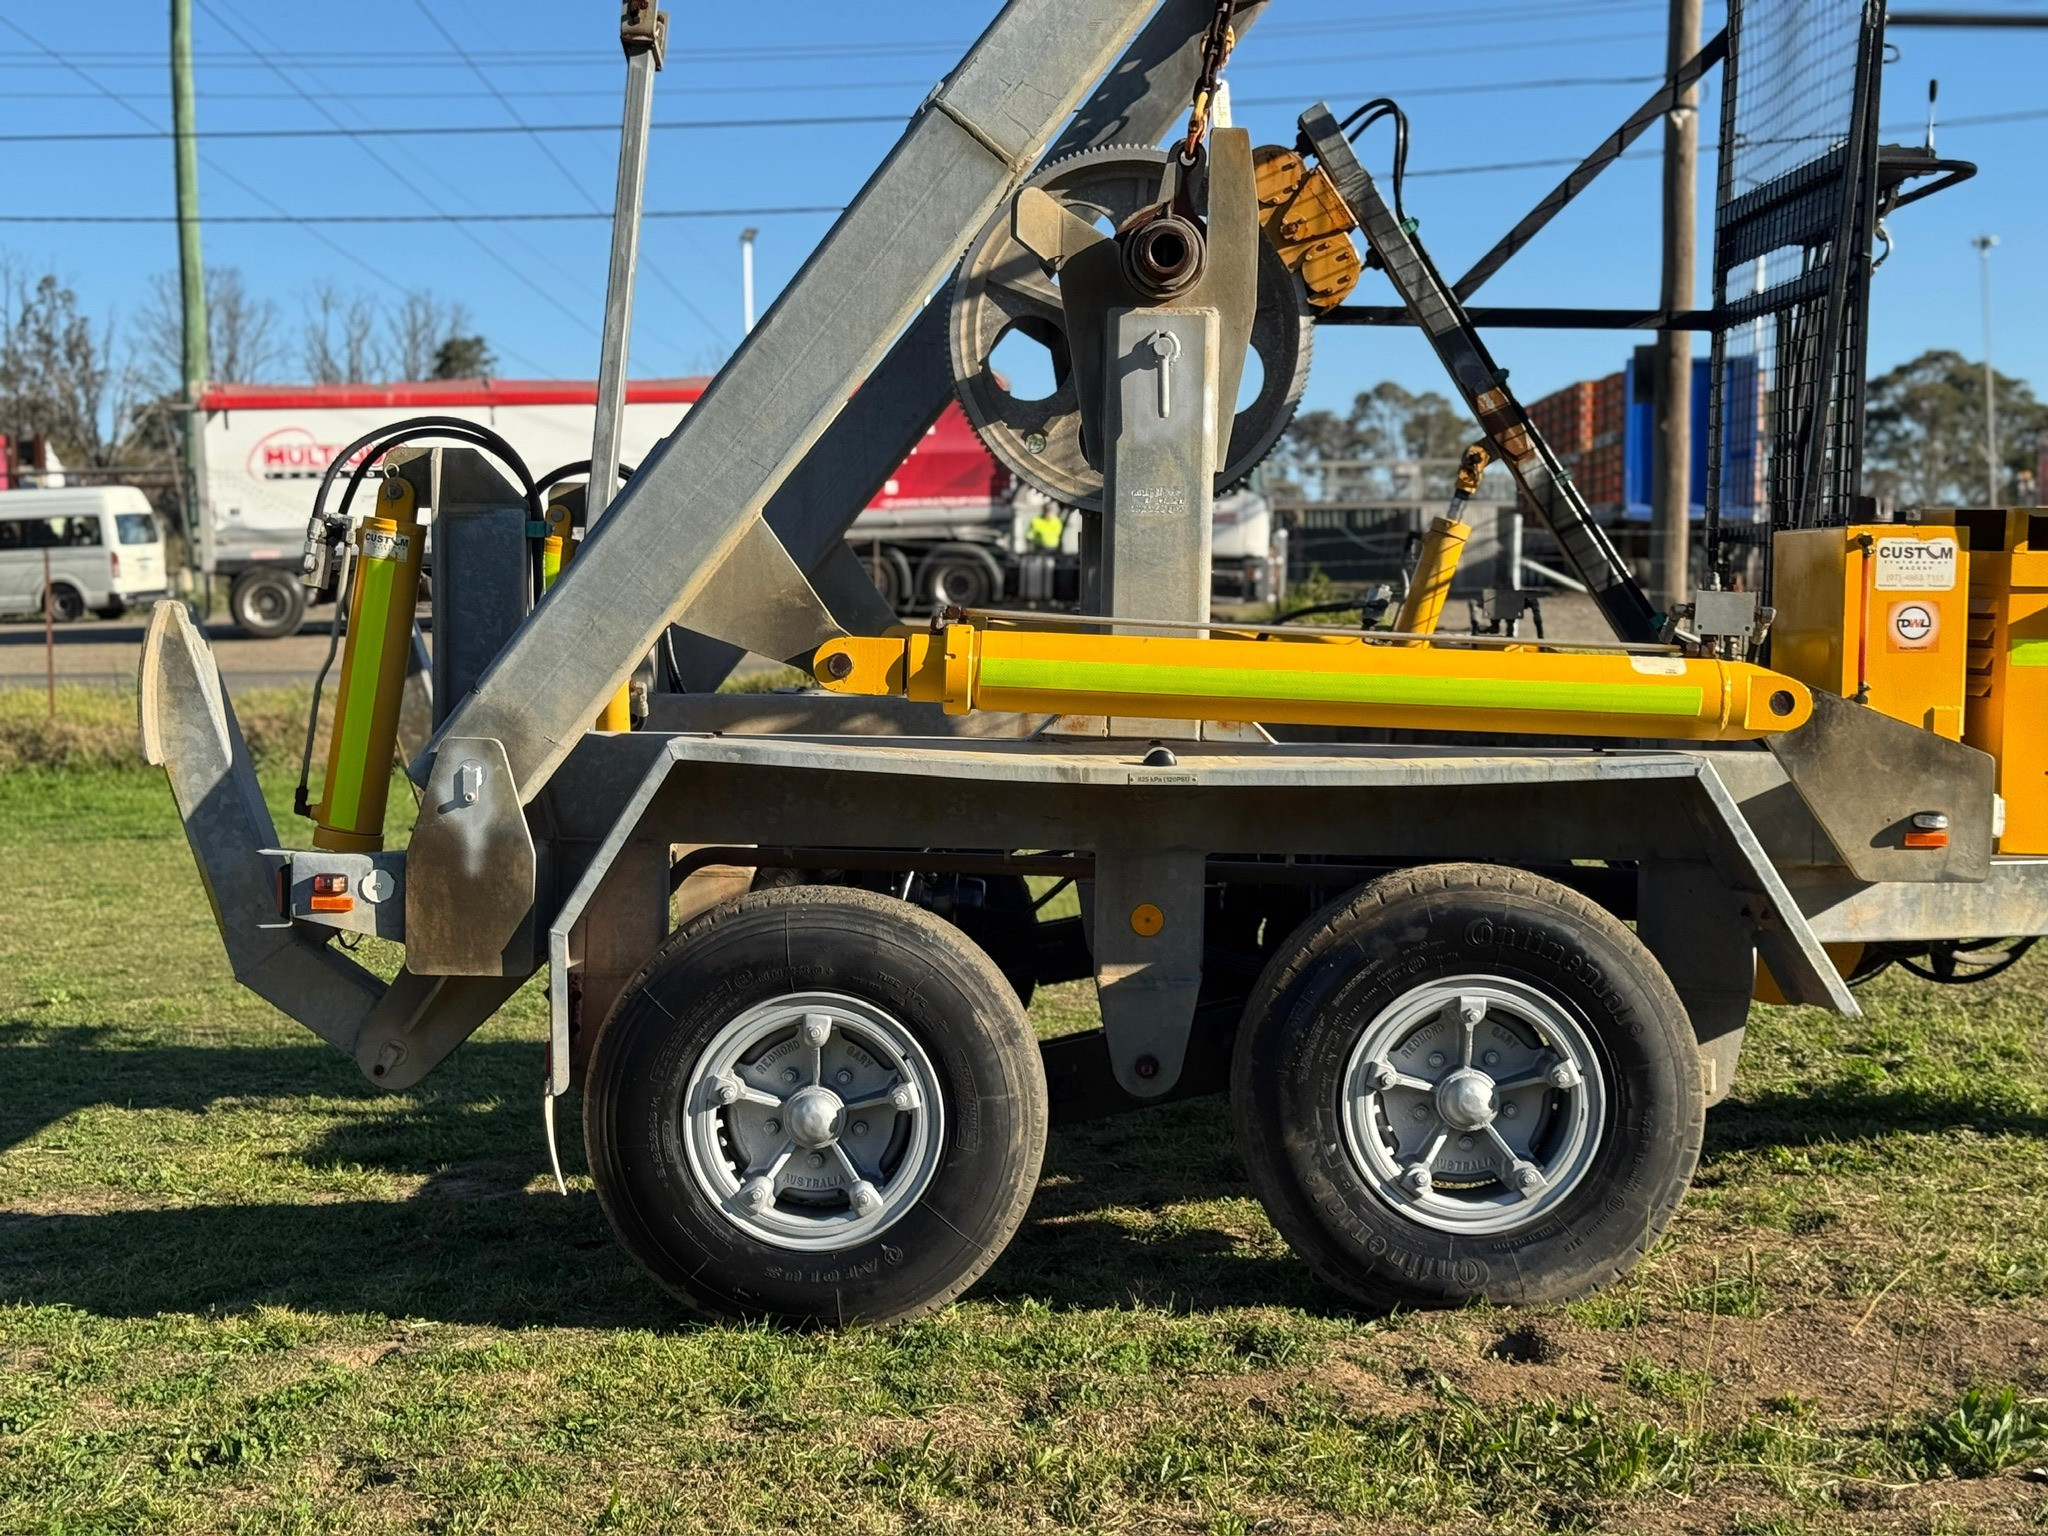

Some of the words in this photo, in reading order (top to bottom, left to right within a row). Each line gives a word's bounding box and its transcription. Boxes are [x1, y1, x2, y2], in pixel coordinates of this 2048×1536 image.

[1401, 1023, 1445, 1060] REDMOND
[756, 1040, 800, 1075] REDMOND
[846, 1045, 874, 1069] GARY
[1433, 1157, 1495, 1172] AUSTRALIA
[782, 1173, 846, 1188] AUSTRALIA
